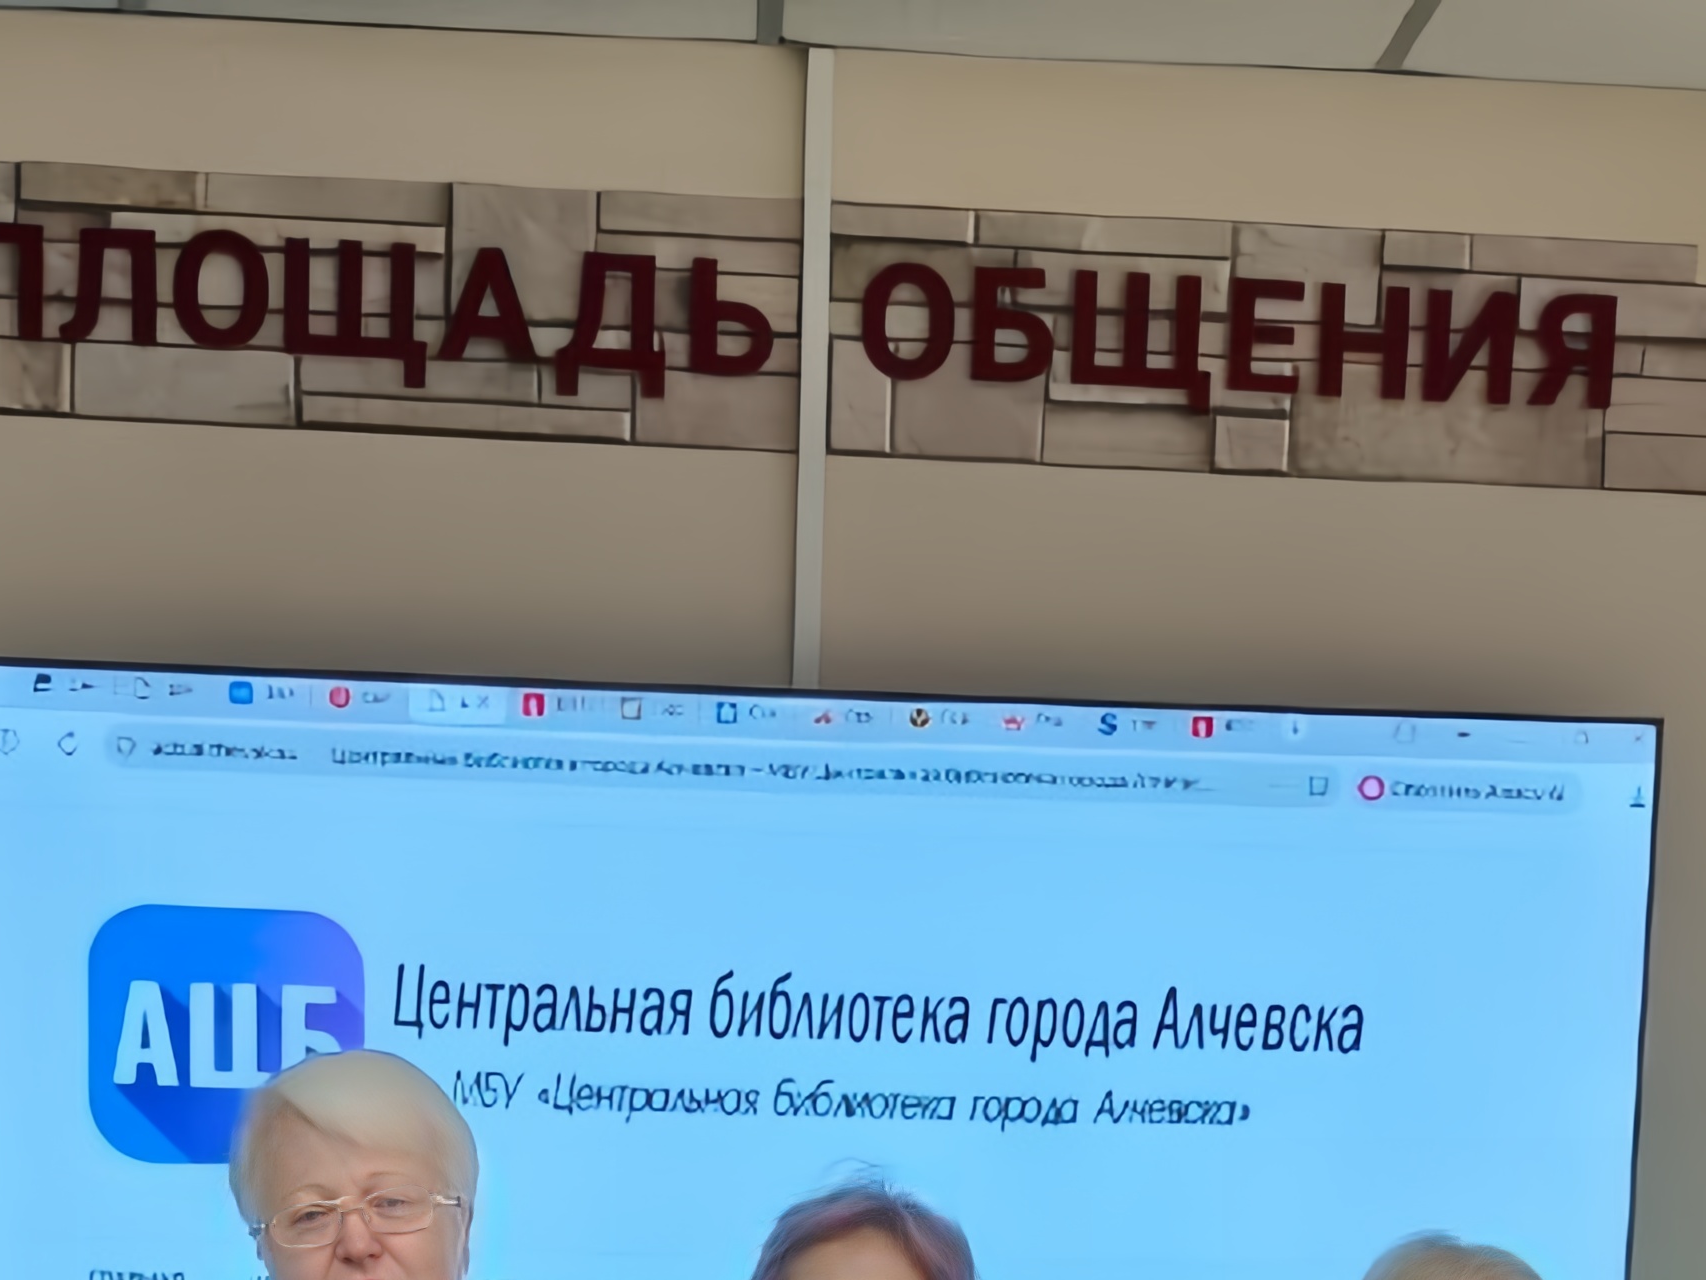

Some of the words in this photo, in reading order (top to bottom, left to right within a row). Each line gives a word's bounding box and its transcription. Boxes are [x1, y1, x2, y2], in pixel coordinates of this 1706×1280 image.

[860, 261, 1619, 415] ОБЩЕНИЯ
[393, 963, 693, 1046] Центральная
[708, 970, 971, 1045] библиотека
[987, 995, 1138, 1062] города
[1152, 986, 1365, 1054] Алчевска
[454, 1070, 525, 1110] МБУ
[968, 1094, 1079, 1132] города
